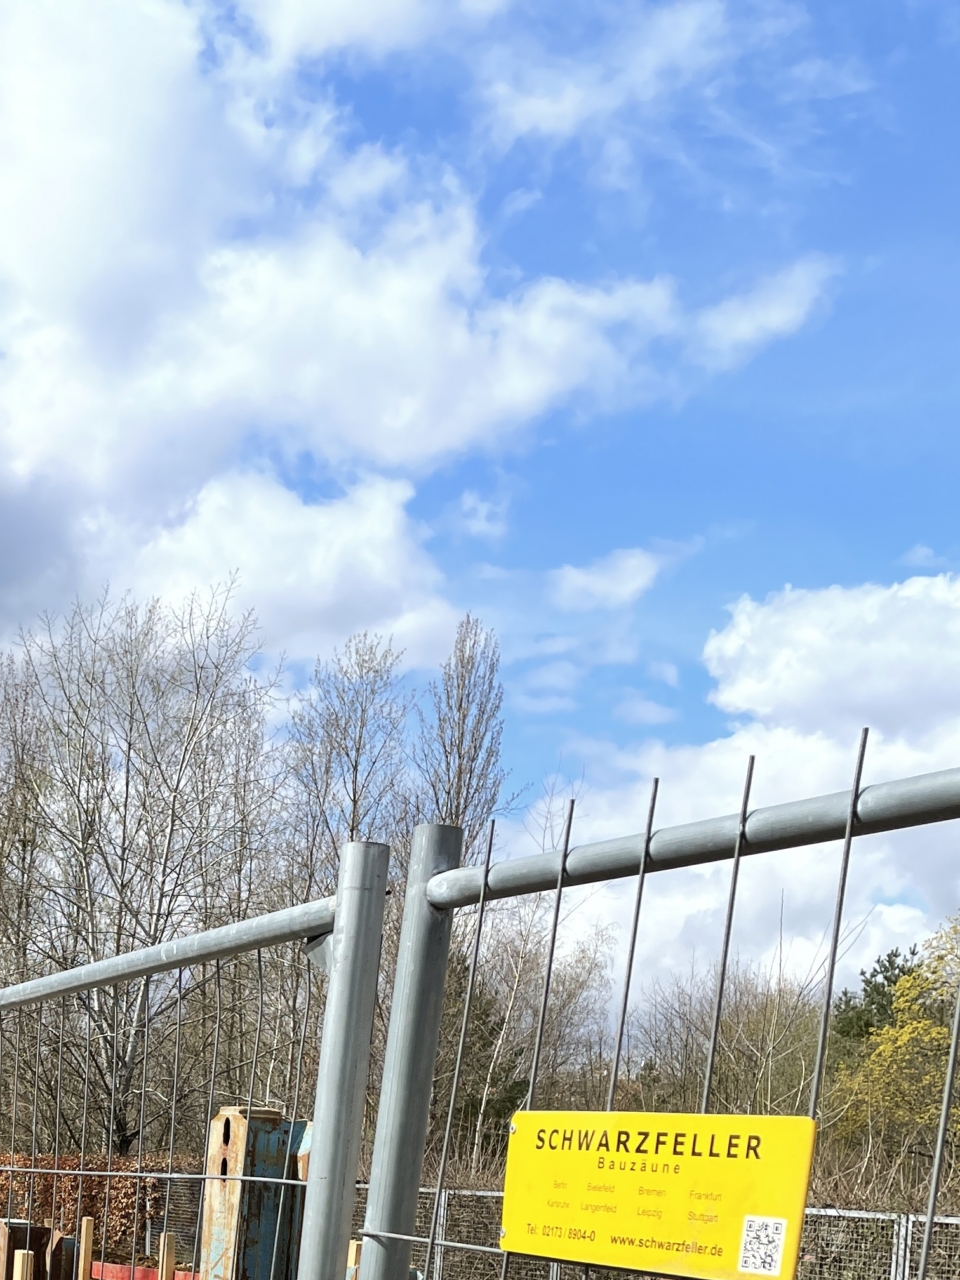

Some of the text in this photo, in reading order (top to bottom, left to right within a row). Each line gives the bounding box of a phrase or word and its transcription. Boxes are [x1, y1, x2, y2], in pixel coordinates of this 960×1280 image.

[535, 1128, 762, 1160] SCHWARZFELLER
[597, 1156, 681, 1174] Bauzäune
[587, 1182, 615, 1193] Bielefeld
[638, 1186, 666, 1197] Bremen
[689, 1189, 722, 1202] Frankfurt
[581, 1202, 617, 1213] Langenfeld
[637, 1206, 663, 1219] Leipzig
[687, 1210, 719, 1224] Stuttgart
[610, 1234, 724, 1258] www.schwarzfeller.de
